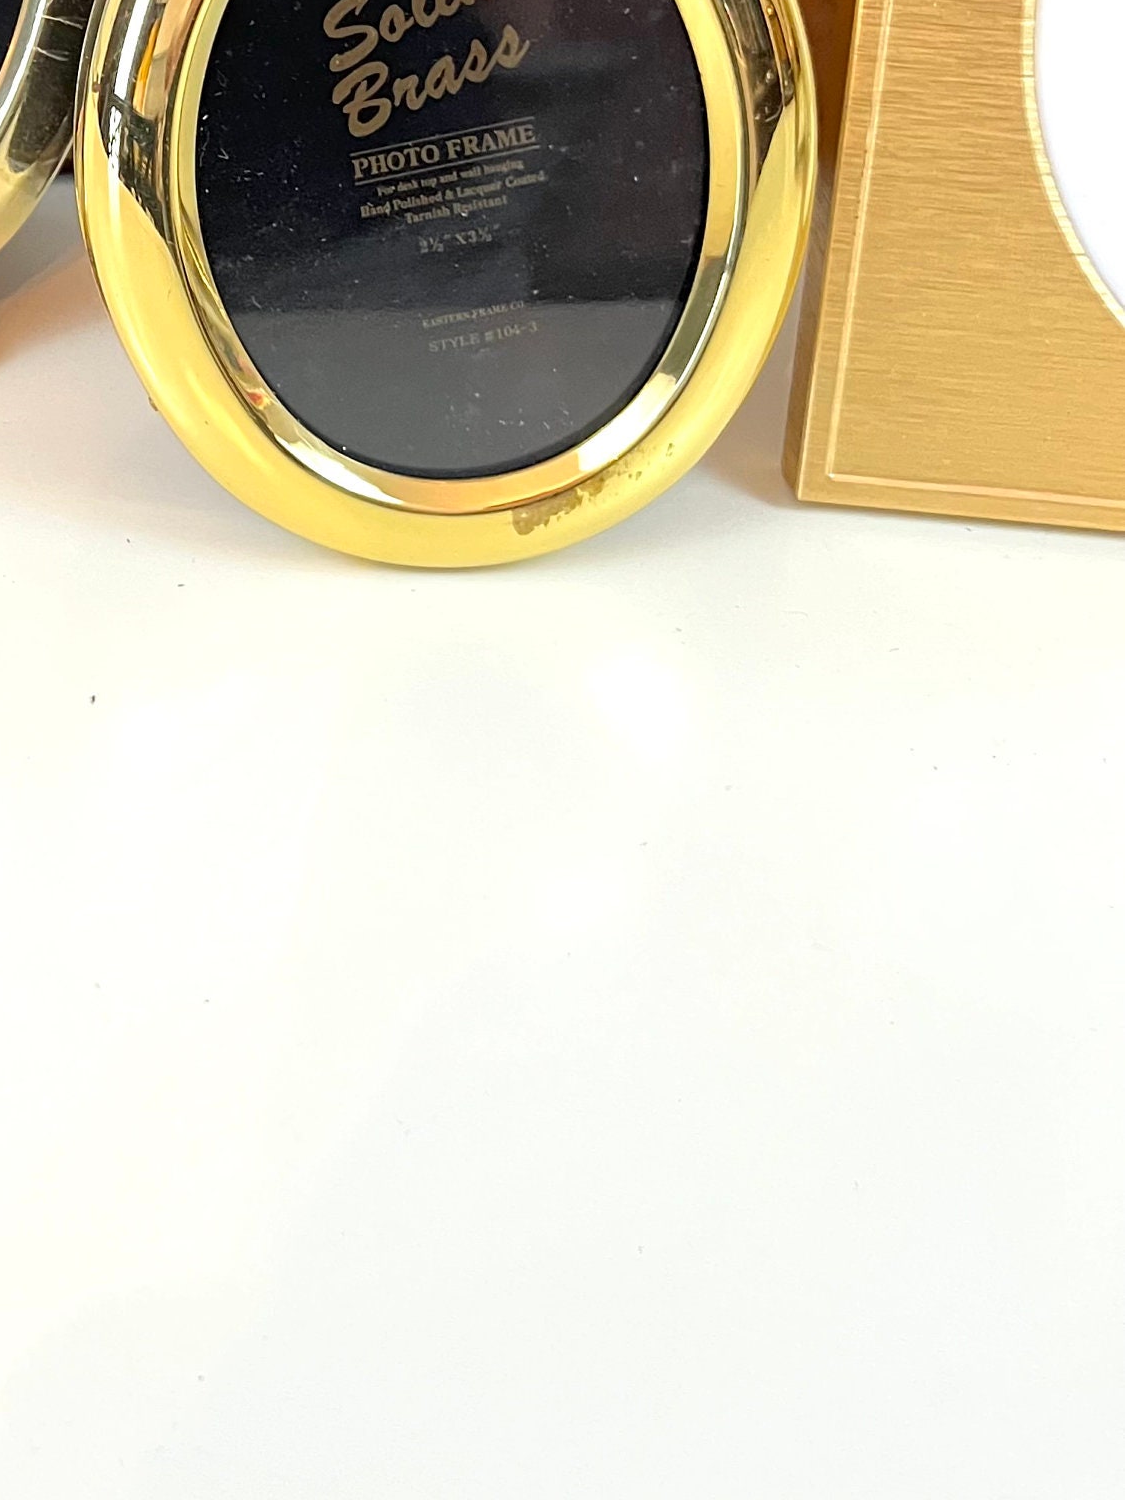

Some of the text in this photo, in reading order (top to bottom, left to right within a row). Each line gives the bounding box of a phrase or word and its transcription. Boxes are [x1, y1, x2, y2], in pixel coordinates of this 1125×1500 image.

[332, 24, 530, 137] Brass
[352, 125, 536, 179] PHOTO FRAME
[439, 171, 458, 184] and
[459, 165, 481, 179] wall
[483, 160, 524, 176] hanging
[360, 169, 545, 218] Hand Polished & Lacquer Coated
[404, 195, 507, 224] Tarnish Resistant
[429, 333, 480, 352] STYLE
